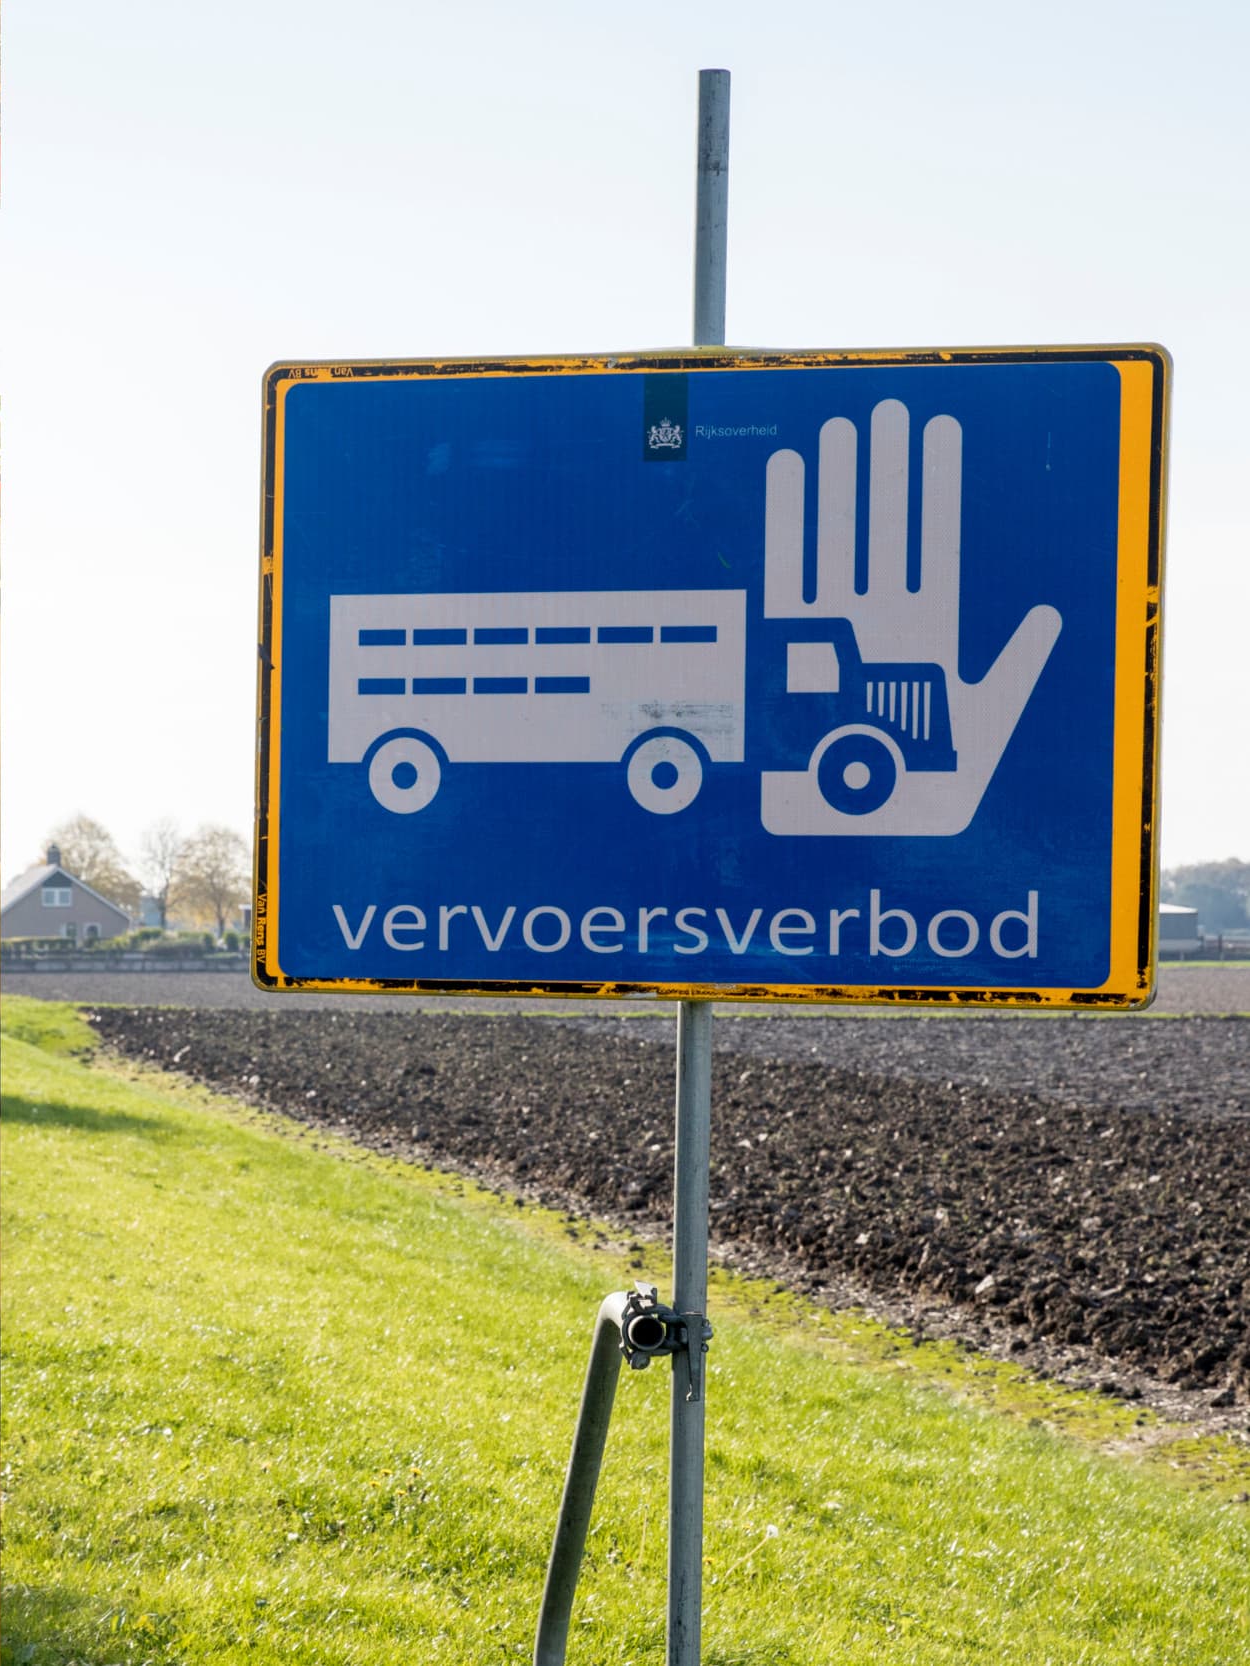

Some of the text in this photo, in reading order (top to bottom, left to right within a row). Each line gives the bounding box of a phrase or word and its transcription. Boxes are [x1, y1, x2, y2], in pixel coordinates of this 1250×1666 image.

[695, 424, 777, 439] Rijksoverheid
[257, 893, 268, 914] Van
[332, 888, 1039, 958] vervoersverbod
[257, 948, 267, 963] BV
